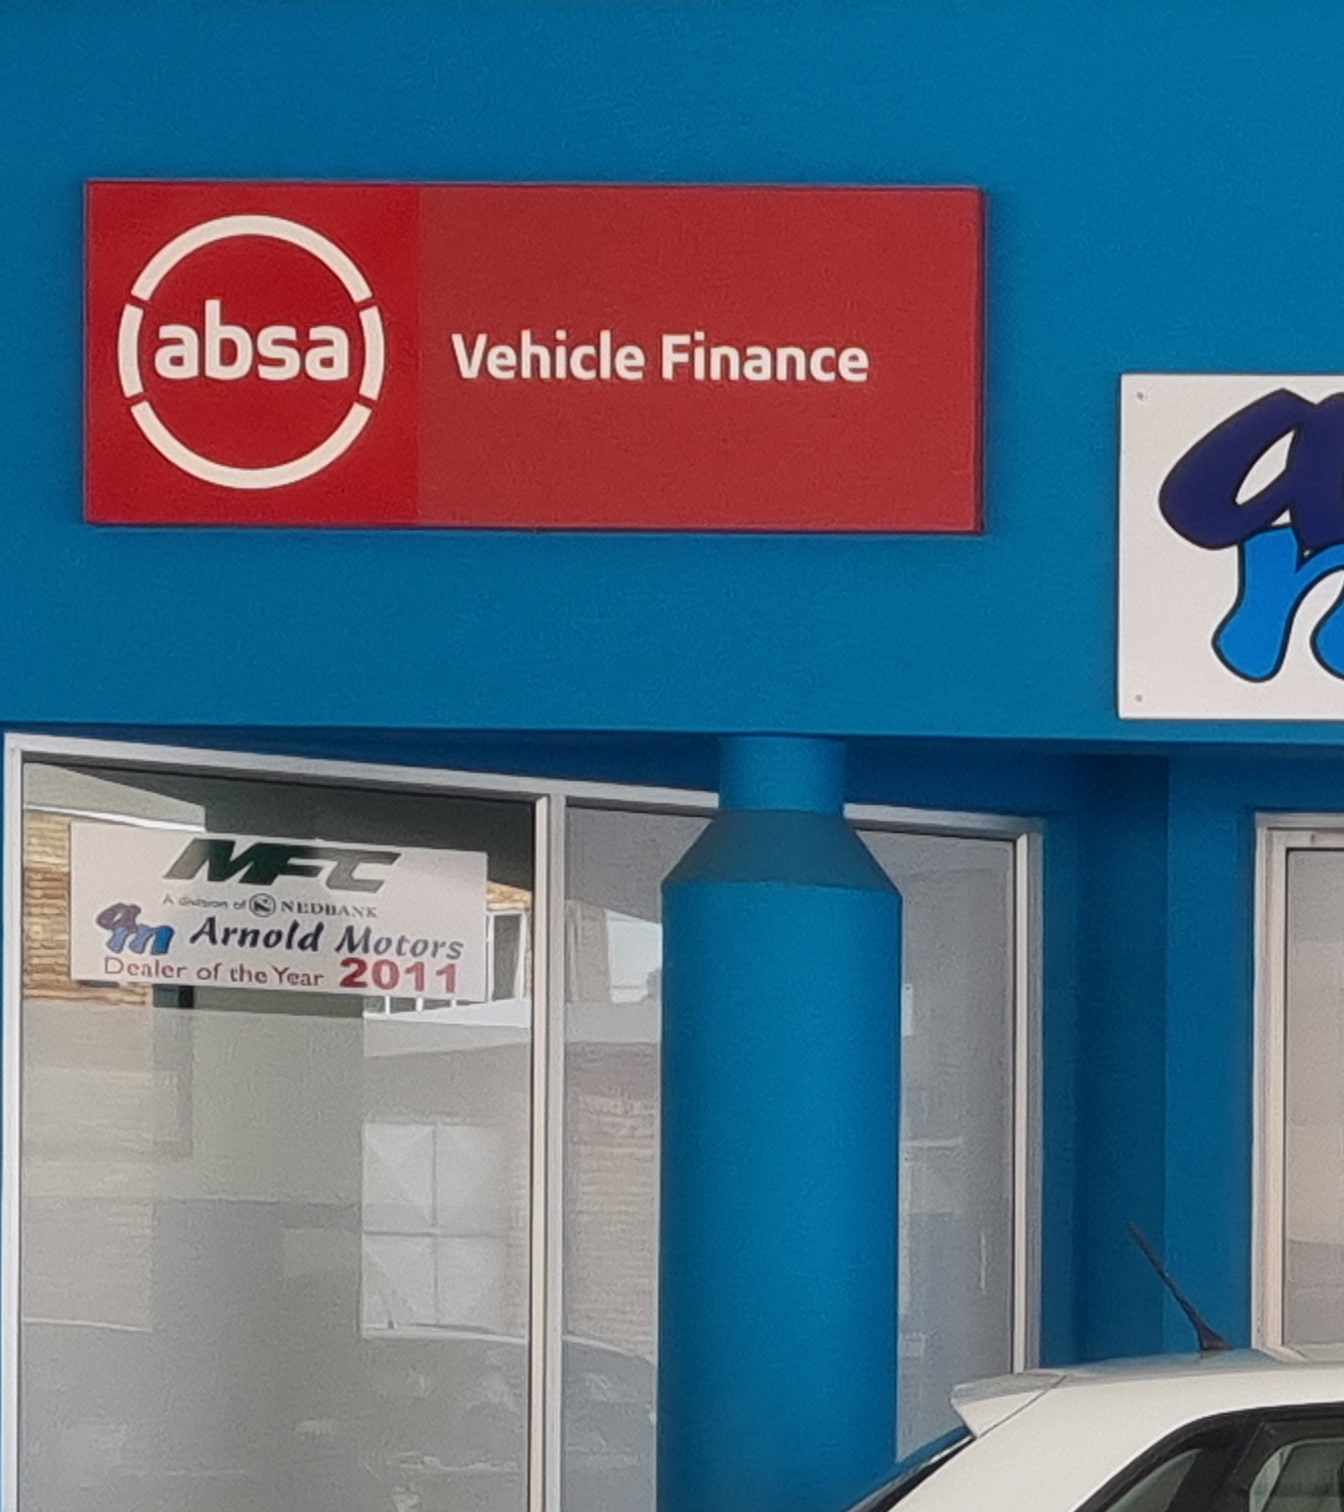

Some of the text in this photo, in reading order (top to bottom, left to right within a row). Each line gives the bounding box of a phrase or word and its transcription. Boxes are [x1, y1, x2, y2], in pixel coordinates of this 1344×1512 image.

[153, 298, 350, 381] absa
[451, 330, 870, 384] Vehicle Finance
[163, 837, 402, 893] MFC
[280, 900, 378, 918] NEDBANK
[189, 916, 464, 960] Arnold Motors
[104, 956, 458, 993] Dealer of the Year 2011
